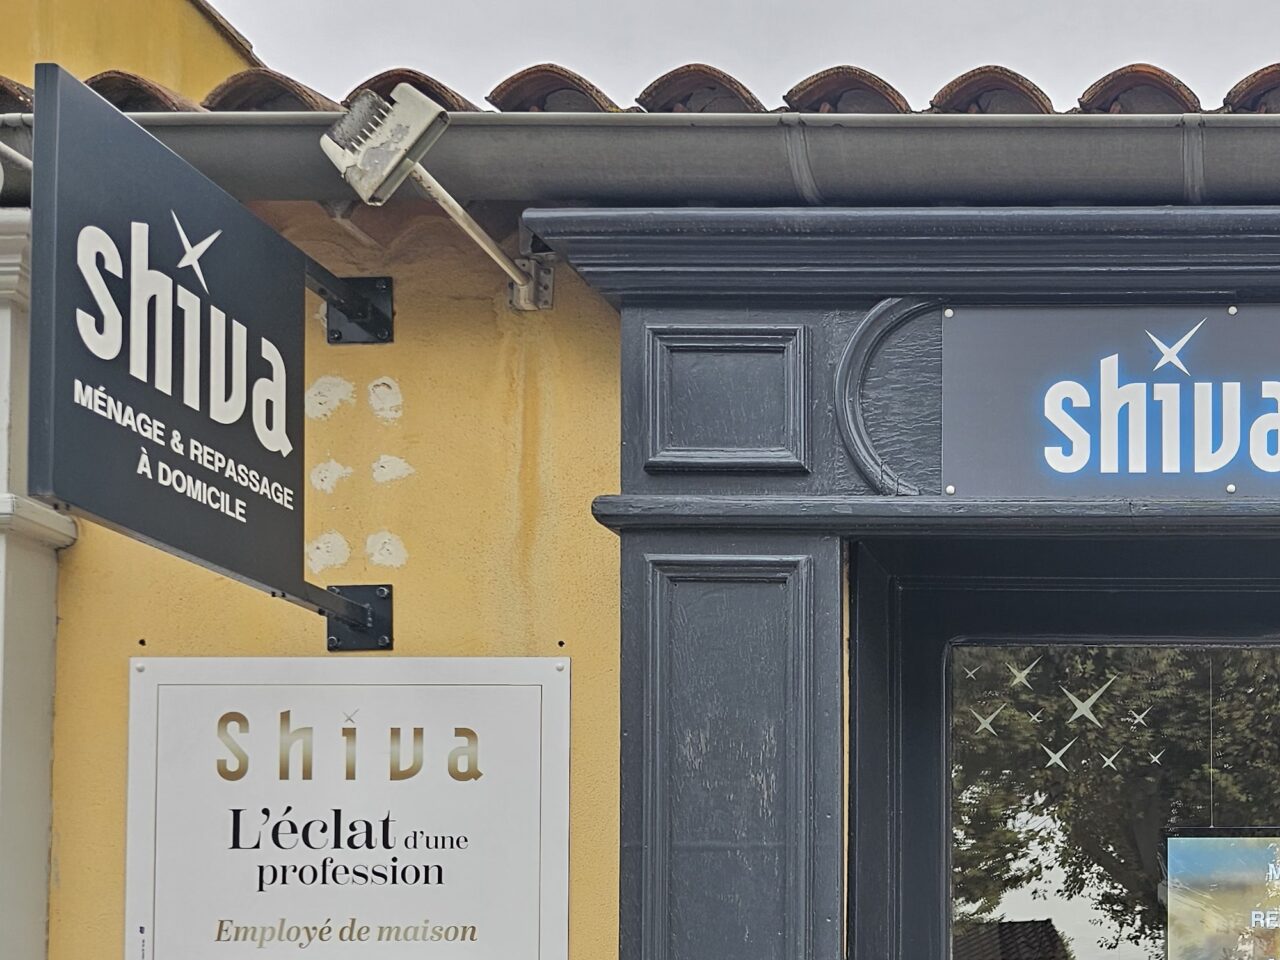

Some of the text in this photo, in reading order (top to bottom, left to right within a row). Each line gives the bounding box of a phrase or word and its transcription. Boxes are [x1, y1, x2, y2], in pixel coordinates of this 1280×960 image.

[76, 209, 293, 458] shiva
[74, 379, 295, 511] MÉNAGE & REPASSAGE
[136, 446, 247, 523] À DOMICILE
[228, 806, 469, 851] L'éclat d'une
[256, 857, 445, 892] profession
[214, 917, 478, 949] Employé de maison
